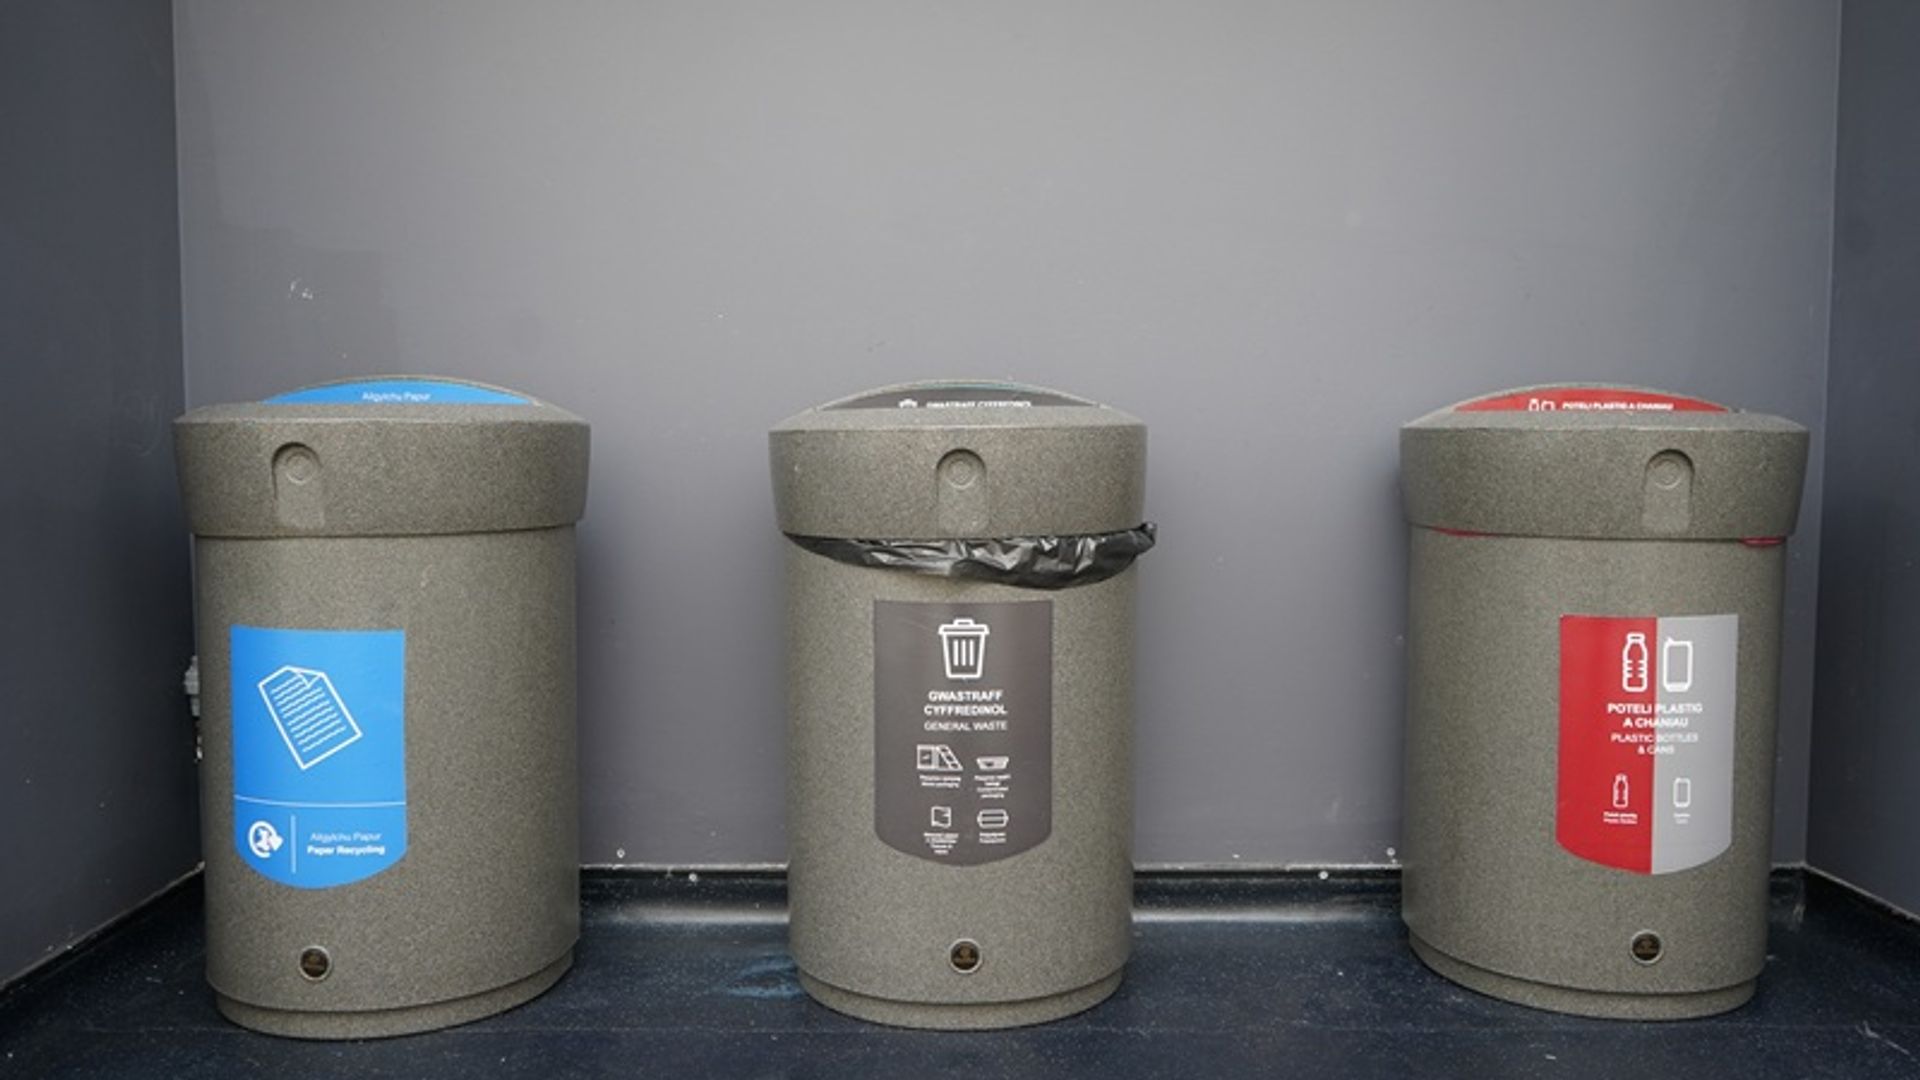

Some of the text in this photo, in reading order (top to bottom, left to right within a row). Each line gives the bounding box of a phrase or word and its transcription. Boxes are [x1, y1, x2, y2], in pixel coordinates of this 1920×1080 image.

[928, 690, 1003, 701] GWASTRAFF
[924, 704, 1008, 716] CYFFREDINOL
[1607, 703, 1703, 714] POTELI PLASTIG
[924, 720, 1008, 731] GENERAL WASTE
[1622, 717, 1689, 728] A CHANIAU
[1611, 732, 1699, 743] PLASTIC BOTTLES
[1637, 745, 1675, 755] & CANS
[353, 832, 382, 843] Papur
[307, 845, 386, 856] Paper Recycling
